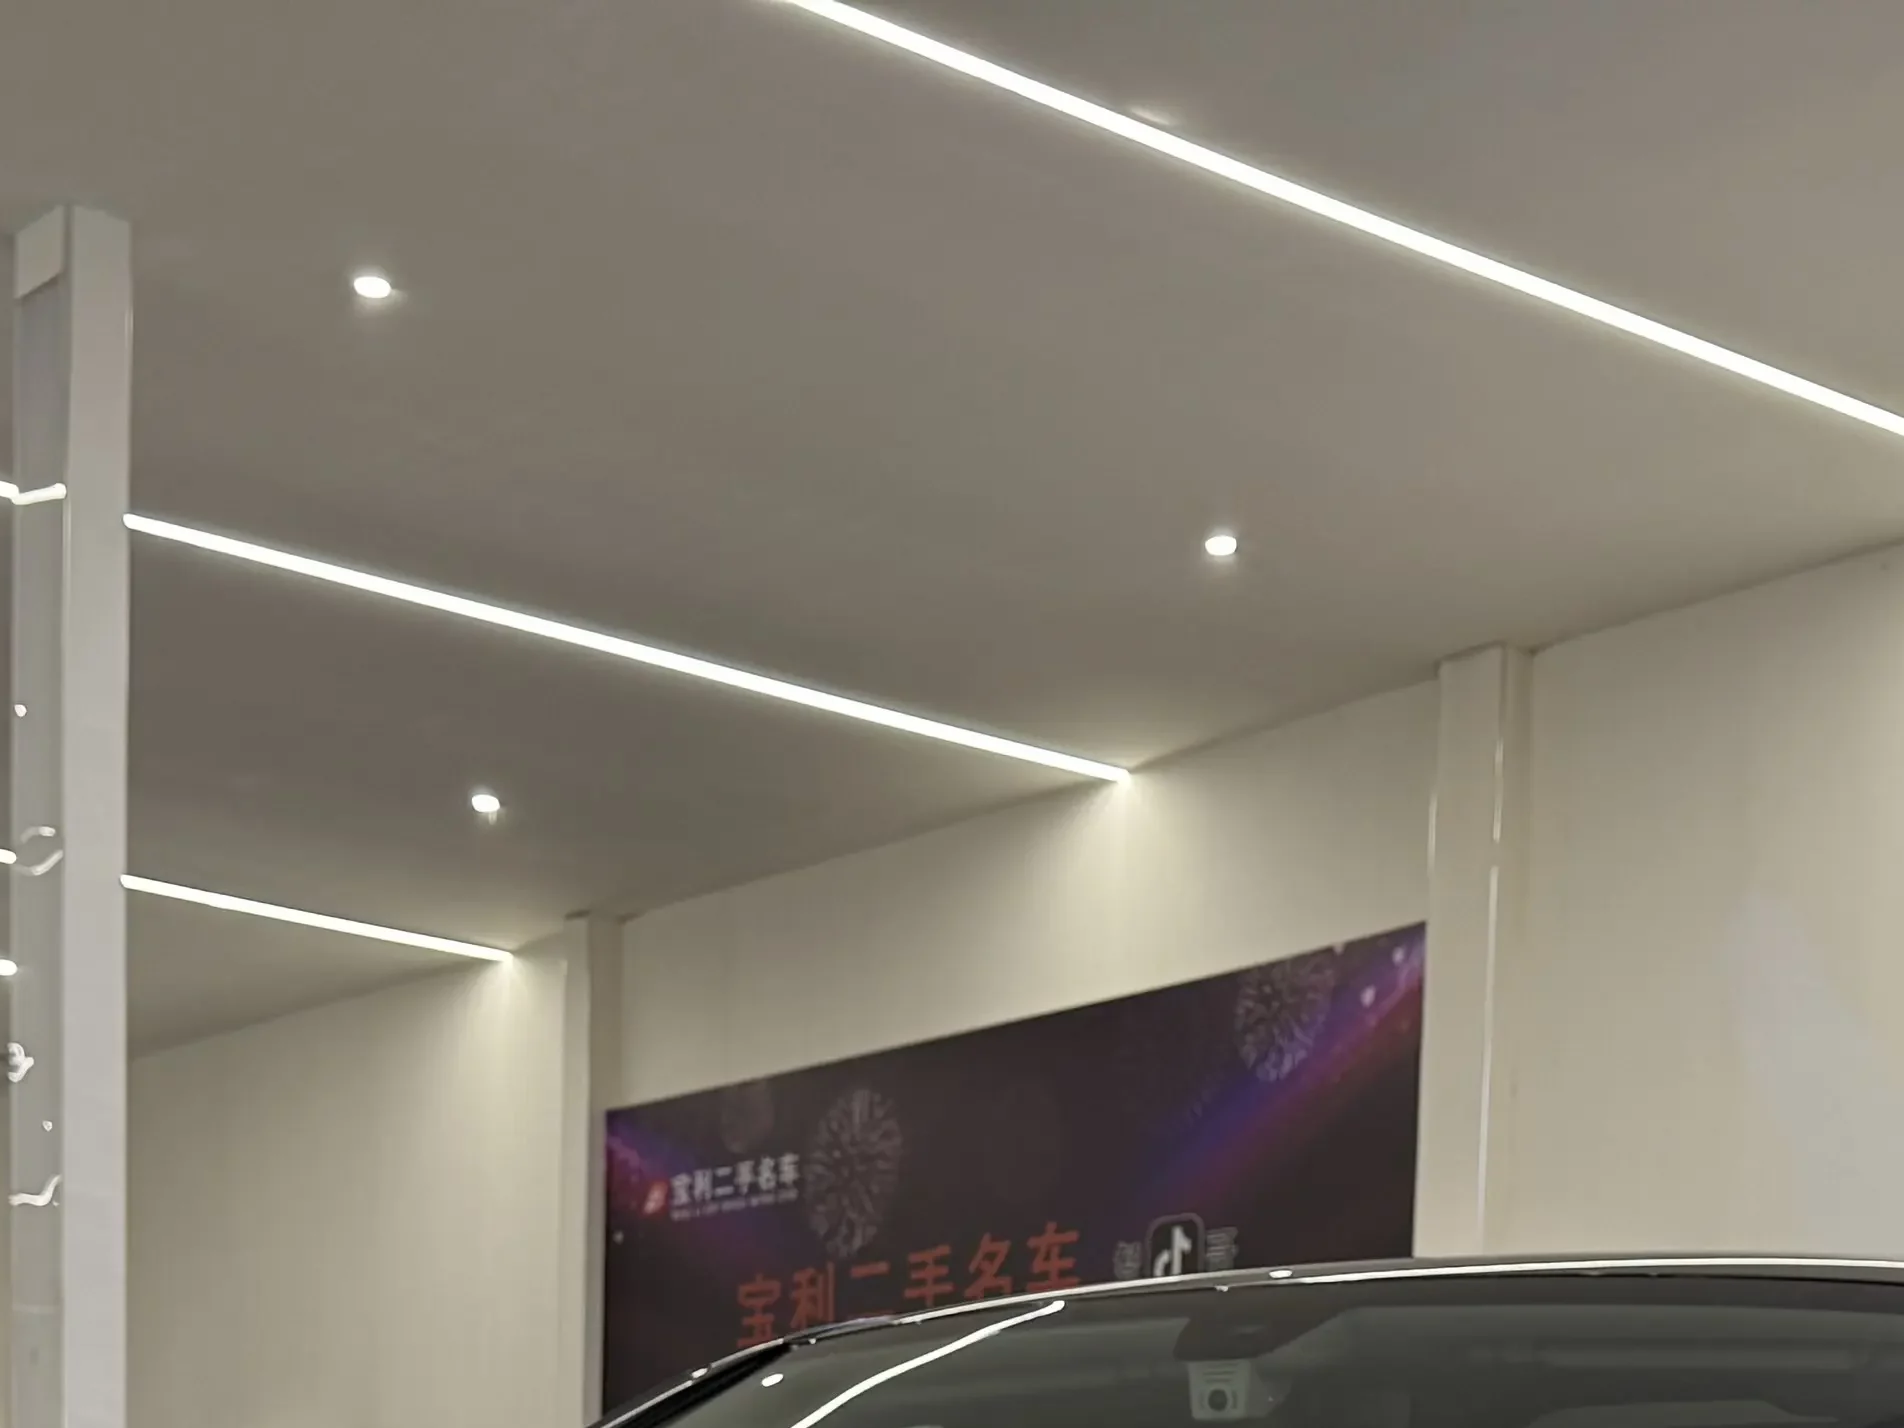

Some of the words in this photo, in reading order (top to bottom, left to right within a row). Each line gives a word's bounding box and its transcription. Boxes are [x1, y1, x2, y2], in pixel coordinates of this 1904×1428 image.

[737, 1221, 1081, 1351] 宝利二手名车
